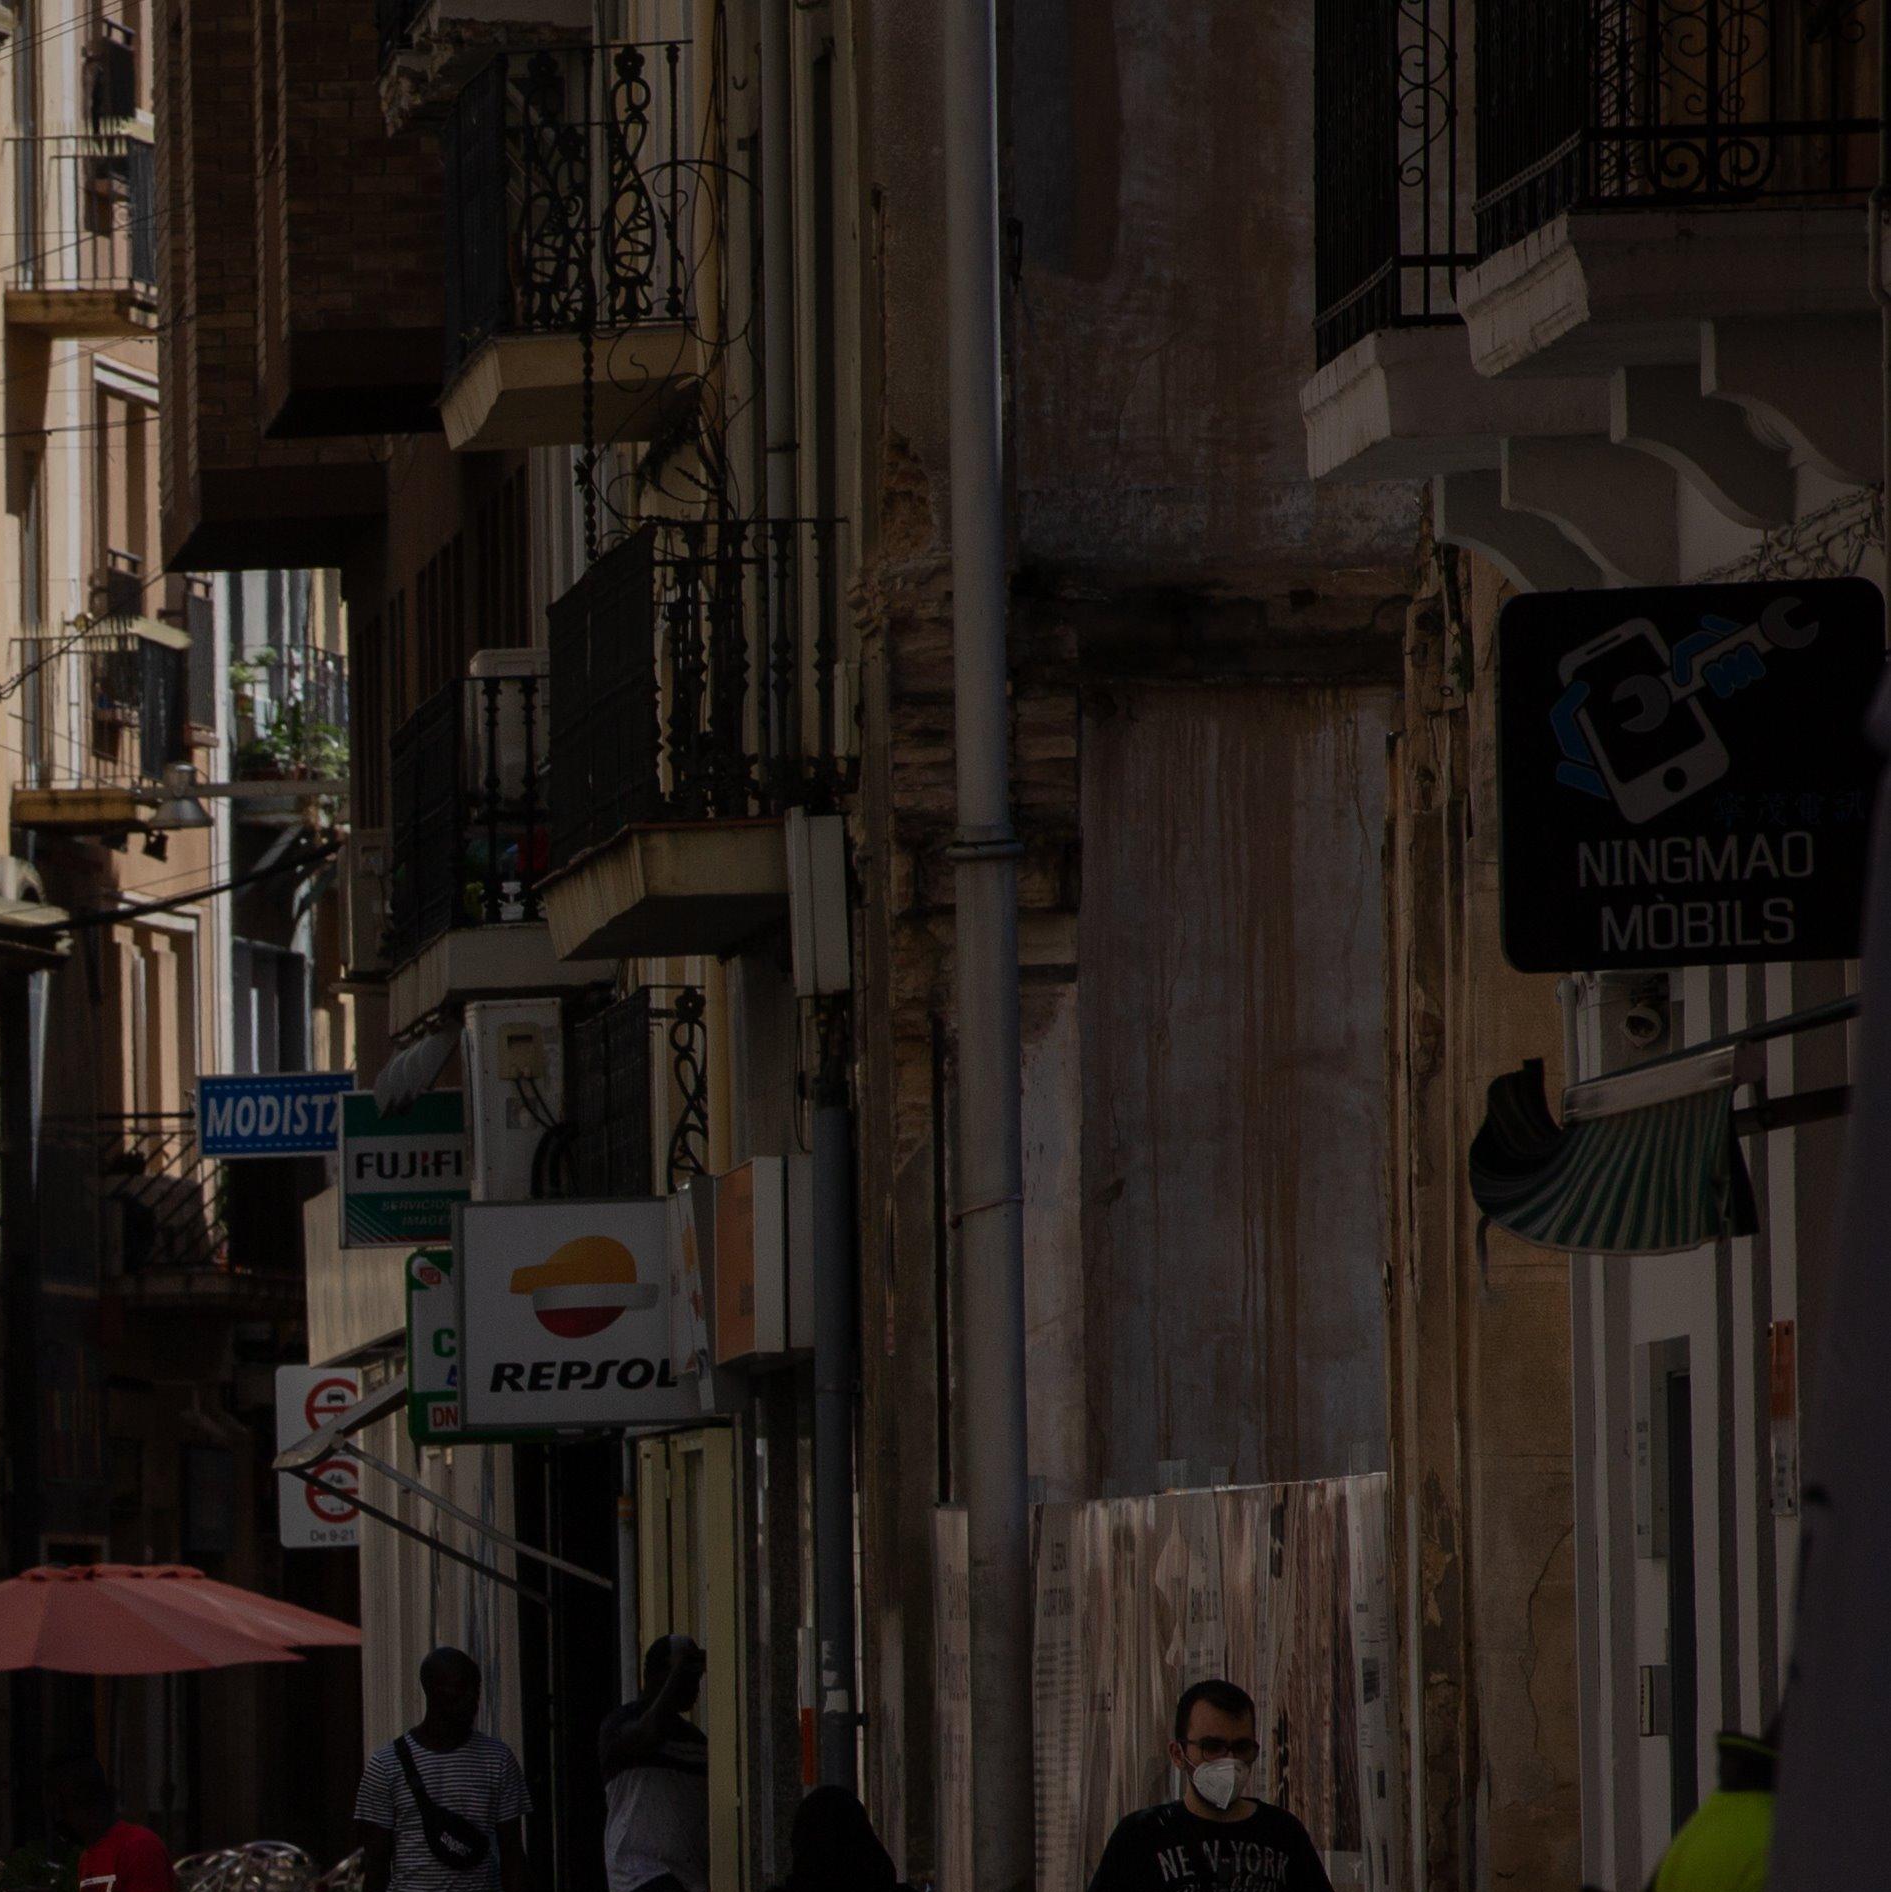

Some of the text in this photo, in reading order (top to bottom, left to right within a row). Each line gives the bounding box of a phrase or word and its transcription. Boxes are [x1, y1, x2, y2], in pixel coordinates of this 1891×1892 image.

[1577, 830, 1814, 887] NINGMAO
[1601, 894, 1796, 951] MÒBILS
[490, 1358, 678, 1392] REPSOL
[310, 1530, 326, 1542] De
